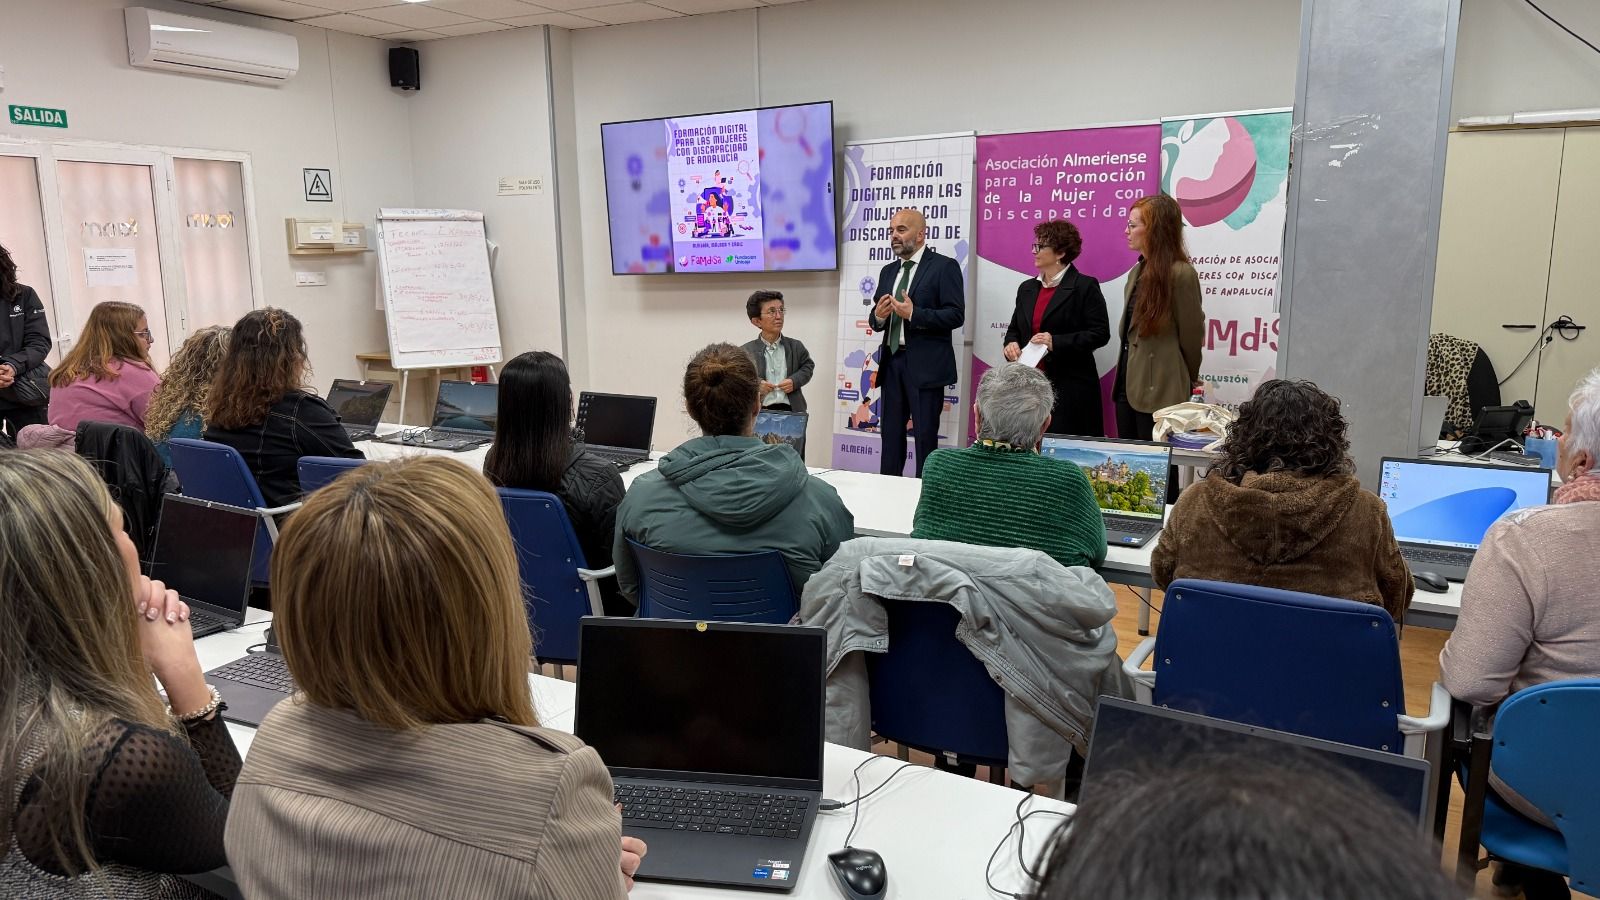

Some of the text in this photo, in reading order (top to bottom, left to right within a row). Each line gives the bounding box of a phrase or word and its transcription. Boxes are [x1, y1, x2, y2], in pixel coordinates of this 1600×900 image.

[14, 107, 64, 125] SALIDA
[674, 123, 748, 138] FORMACIÓN DIGITAL
[675, 133, 747, 147] PARA LAS MUJERES
[676, 143, 748, 157] CON DISCAPACIDAD
[686, 151, 738, 165] DE ANDALUCÍA
[985, 152, 1147, 171] Asociación Almeriense
[870, 160, 943, 181] FORMACIÓN
[985, 167, 1145, 190] para la Promoción
[851, 183, 962, 202] DIGITAL PARA LAS
[984, 188, 1144, 204] de la Mujer con
[922, 205, 948, 219] CON
[984, 204, 1127, 221] Discapacida
[945, 226, 961, 239] DE
[1187, 254, 1279, 265] ERACIÓN DE ASOCIA
[1199, 271, 1278, 280] ERES CON DISCA
[1205, 287, 1217, 295] DE
[1203, 317, 1280, 356] MdiS
[1200, 374, 1248, 384] NCLUSIÓN
[841, 444, 873, 455] ALMERÍA
